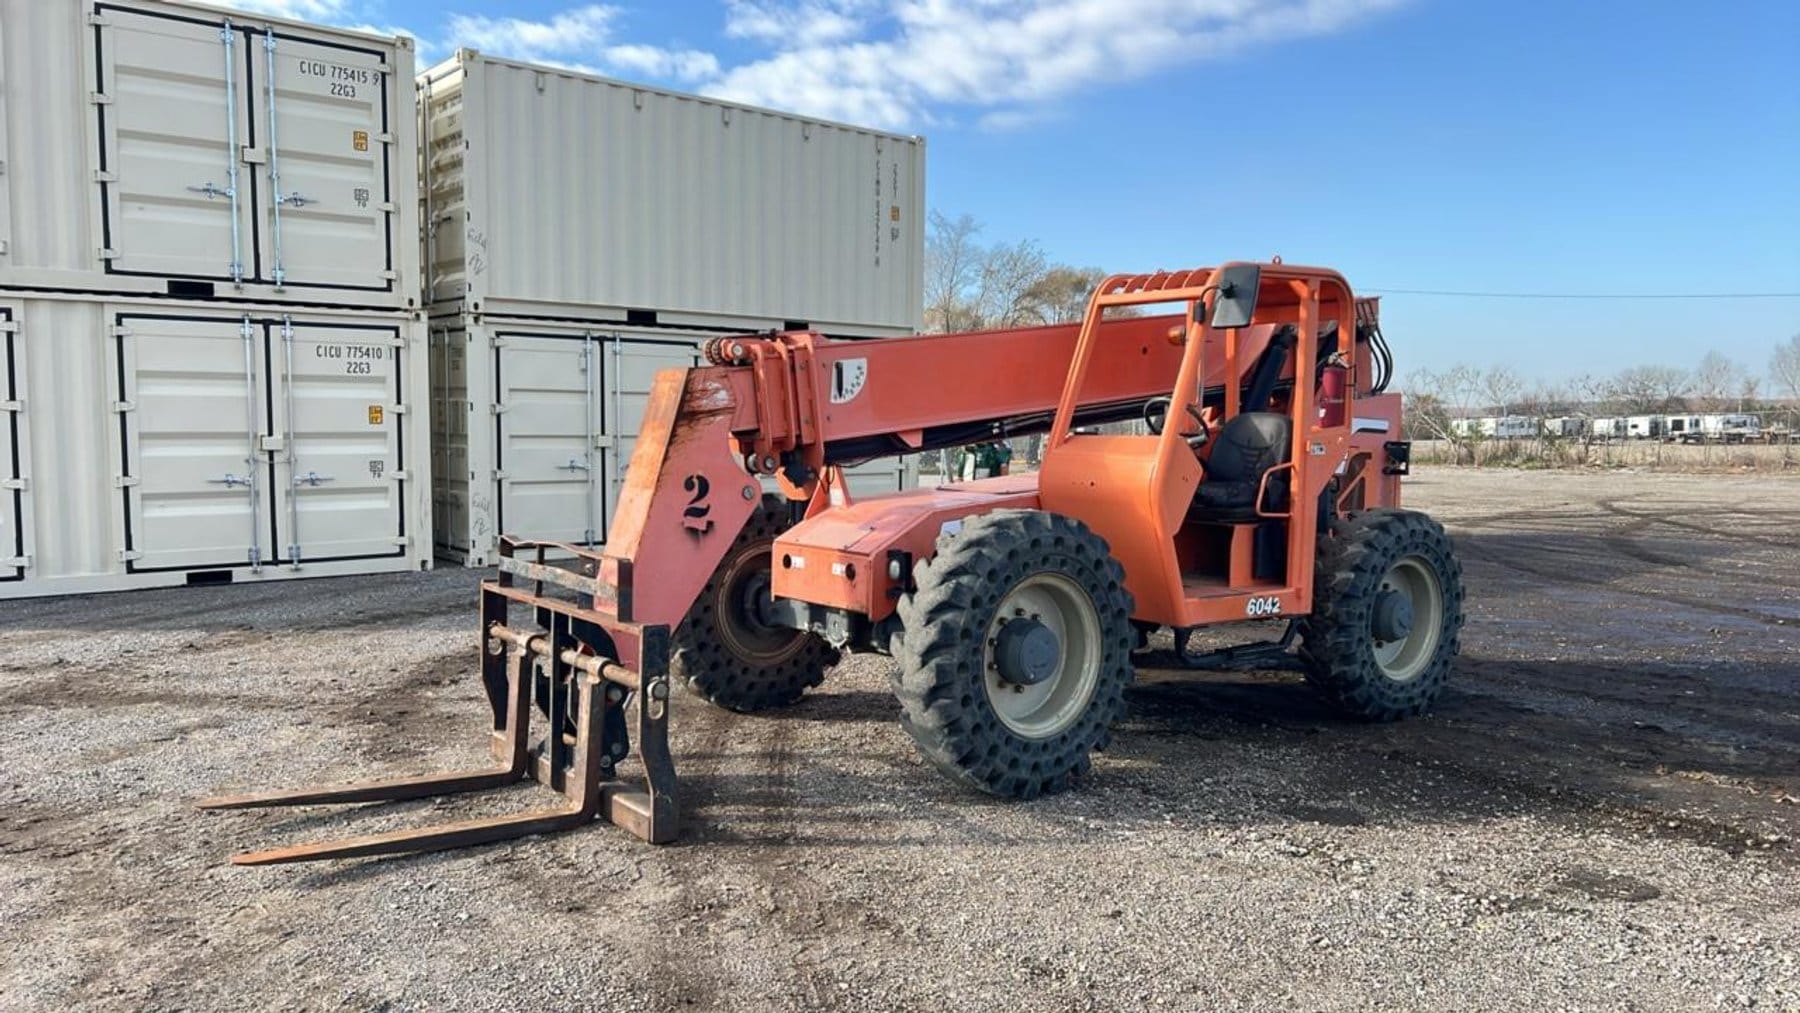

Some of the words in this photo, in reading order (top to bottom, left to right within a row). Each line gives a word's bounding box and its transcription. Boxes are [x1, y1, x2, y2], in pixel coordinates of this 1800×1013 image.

[300, 61, 326, 77] CICU
[330, 66, 368, 84] 775415
[372, 73, 380, 86] 9
[330, 83, 356, 98] 22G3
[316, 345, 342, 359] CICU
[346, 346, 383, 360] 775410
[346, 361, 371, 374] 22G3
[683, 474, 711, 518] 2
[1247, 596, 1281, 615] 6042
